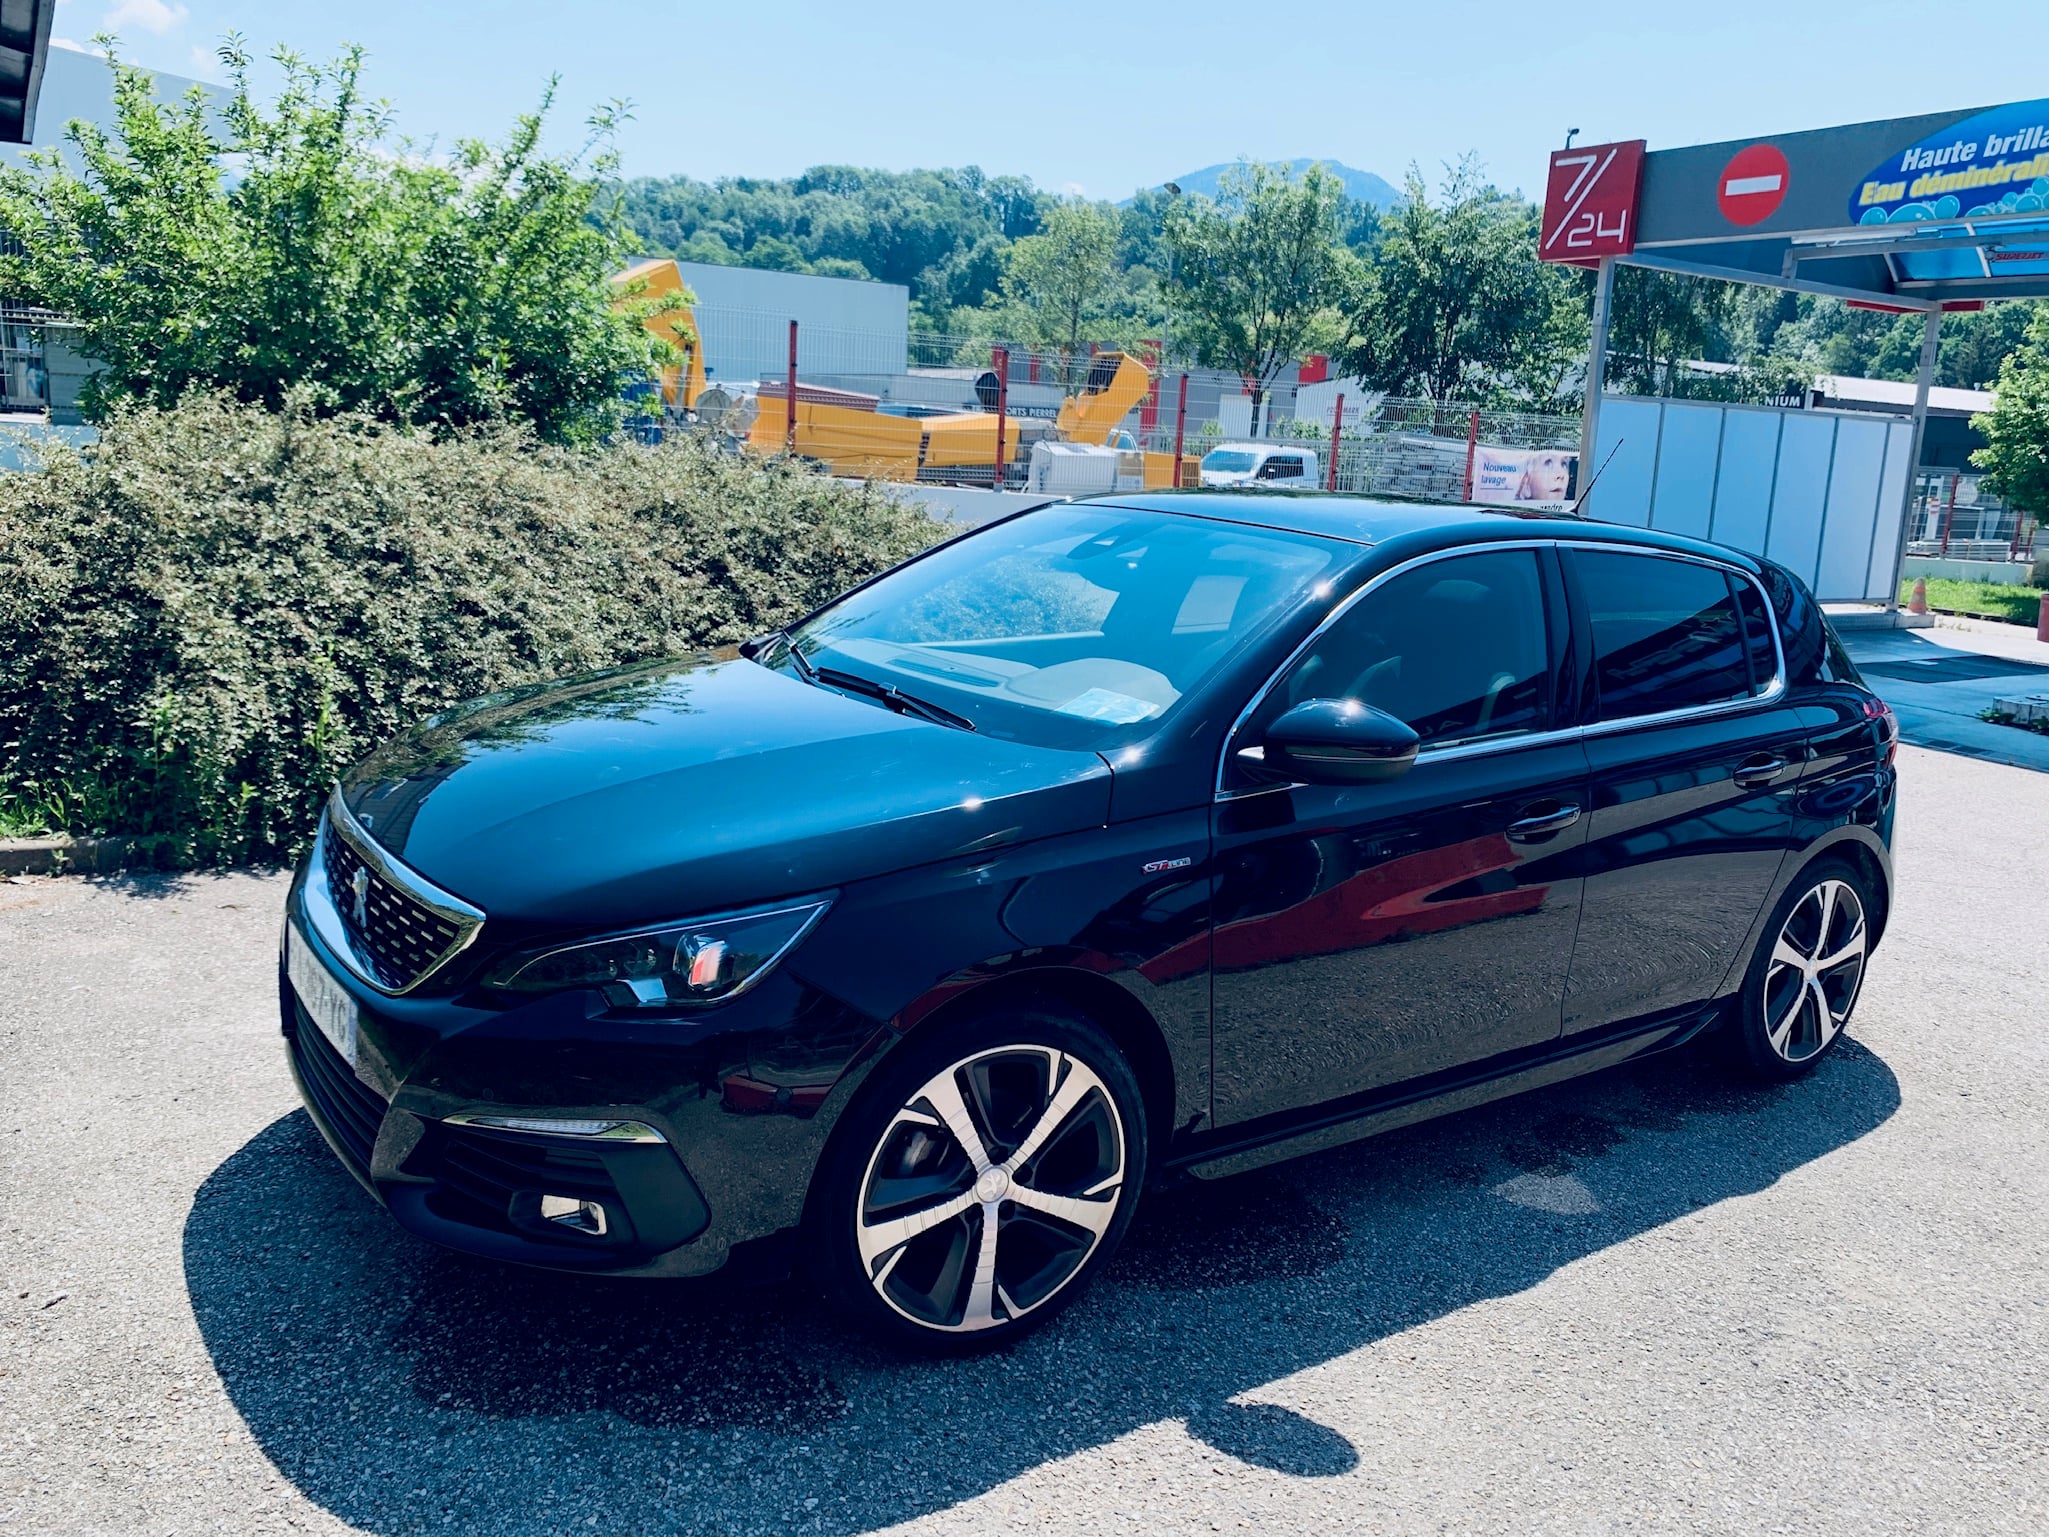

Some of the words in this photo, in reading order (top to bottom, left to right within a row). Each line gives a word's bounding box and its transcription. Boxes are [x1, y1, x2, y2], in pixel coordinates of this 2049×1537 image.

[1900, 140, 1977, 172] Haute
[1858, 180, 1907, 207] Eau
[1908, 152, 2049, 199] déminérali
[1483, 462, 1517, 473] Nouveau
[1480, 474, 1507, 487] lavage
